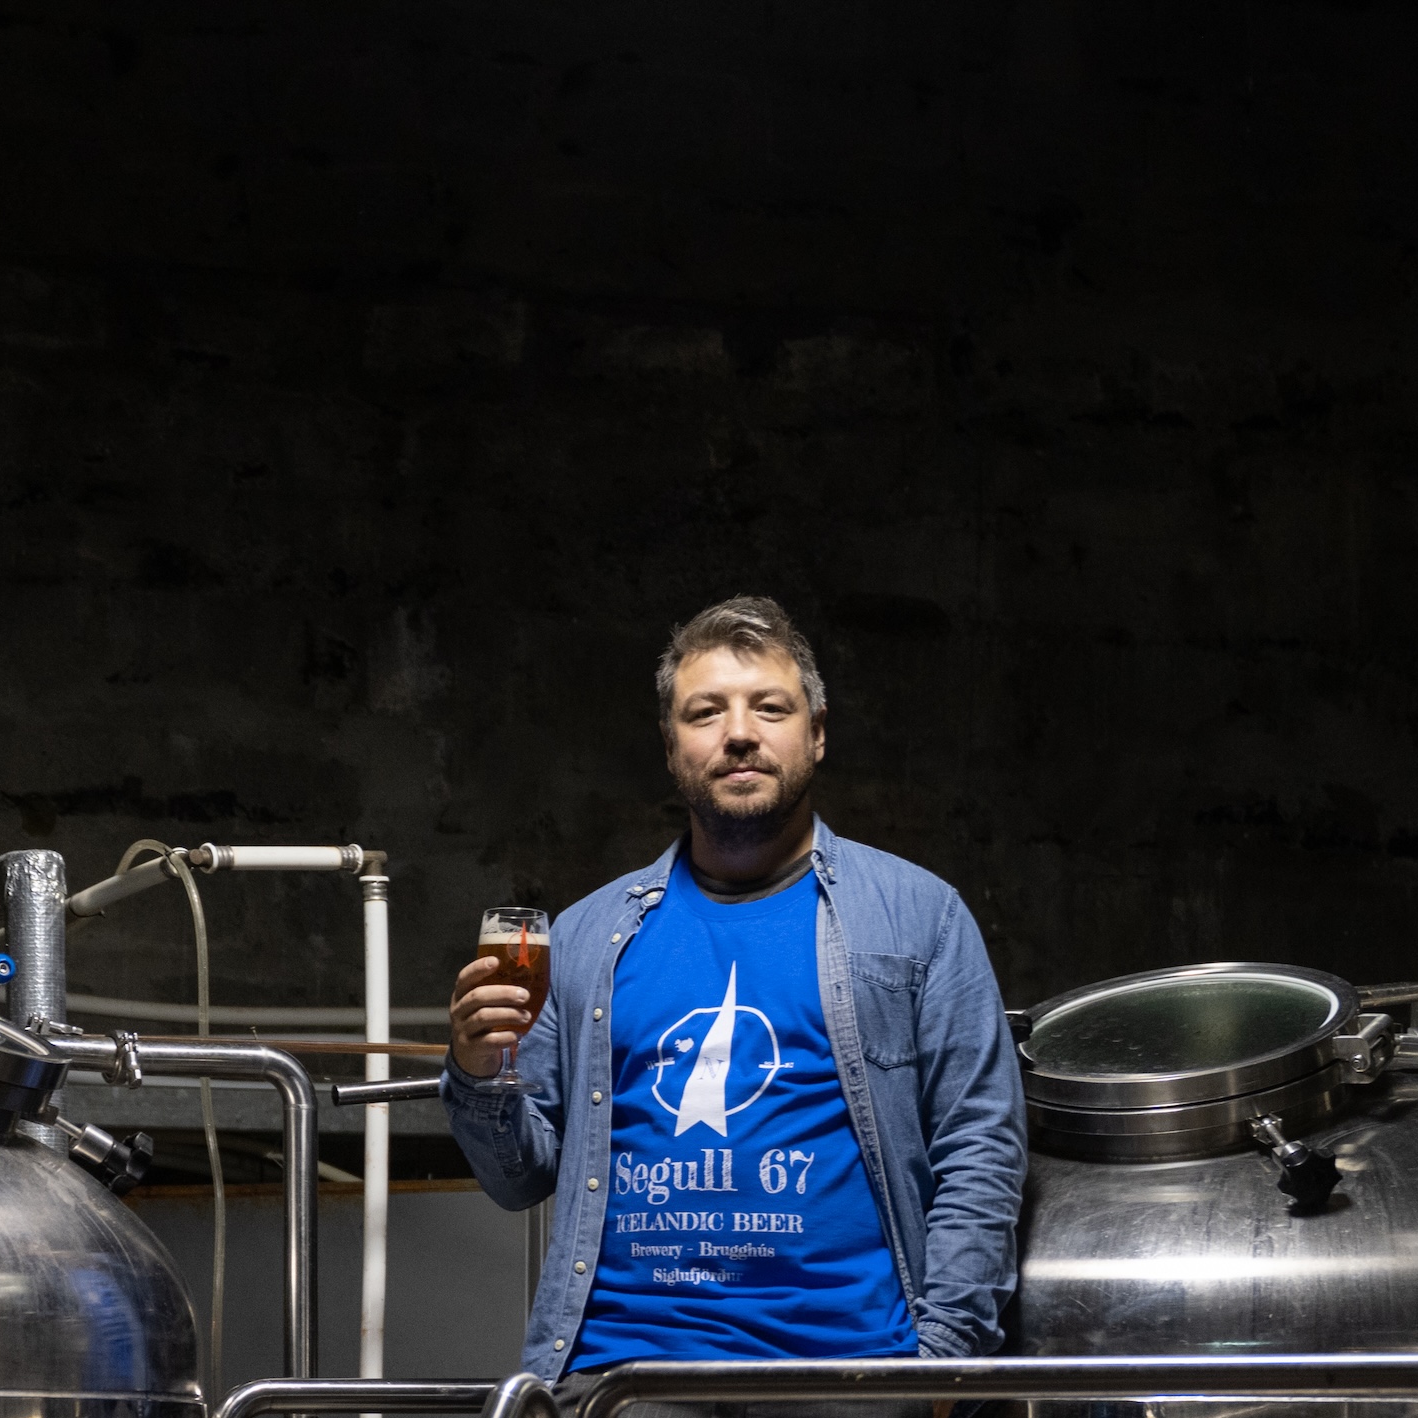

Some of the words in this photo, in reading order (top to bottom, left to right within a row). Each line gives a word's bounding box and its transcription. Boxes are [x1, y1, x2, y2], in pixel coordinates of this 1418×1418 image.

[697, 1057, 725, 1080] N
[615, 1148, 739, 1205] Segull
[758, 1148, 816, 1195] 67
[615, 1211, 724, 1234] ICELANDIC
[731, 1212, 804, 1234] BEER
[630, 1242, 683, 1260] Brewery
[698, 1241, 776, 1260] Brugghús
